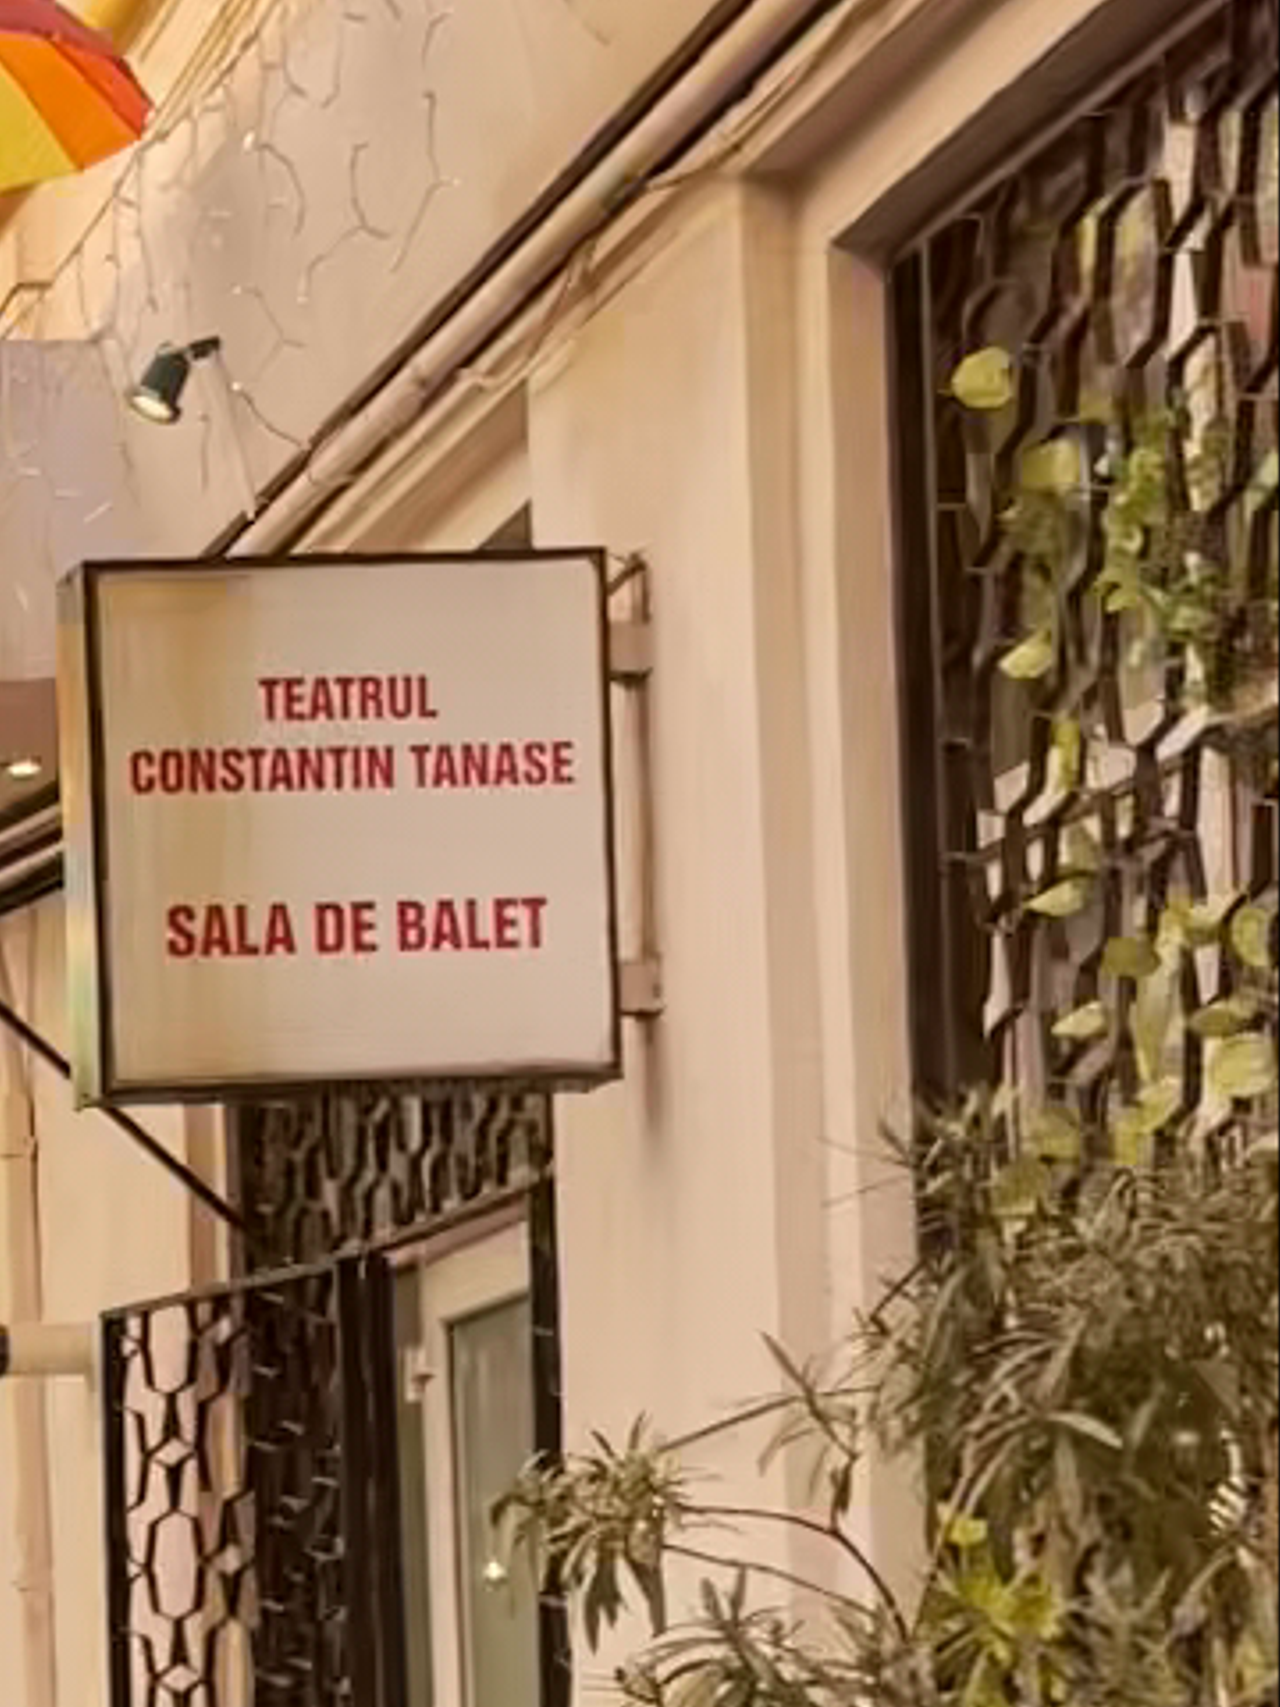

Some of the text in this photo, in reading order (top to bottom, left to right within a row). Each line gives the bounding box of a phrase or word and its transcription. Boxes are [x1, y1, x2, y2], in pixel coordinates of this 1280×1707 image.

[259, 677, 438, 723] TEATRUL
[128, 740, 576, 794] CONSTANTIN TANASE
[166, 897, 547, 958] SALA DE BALET
